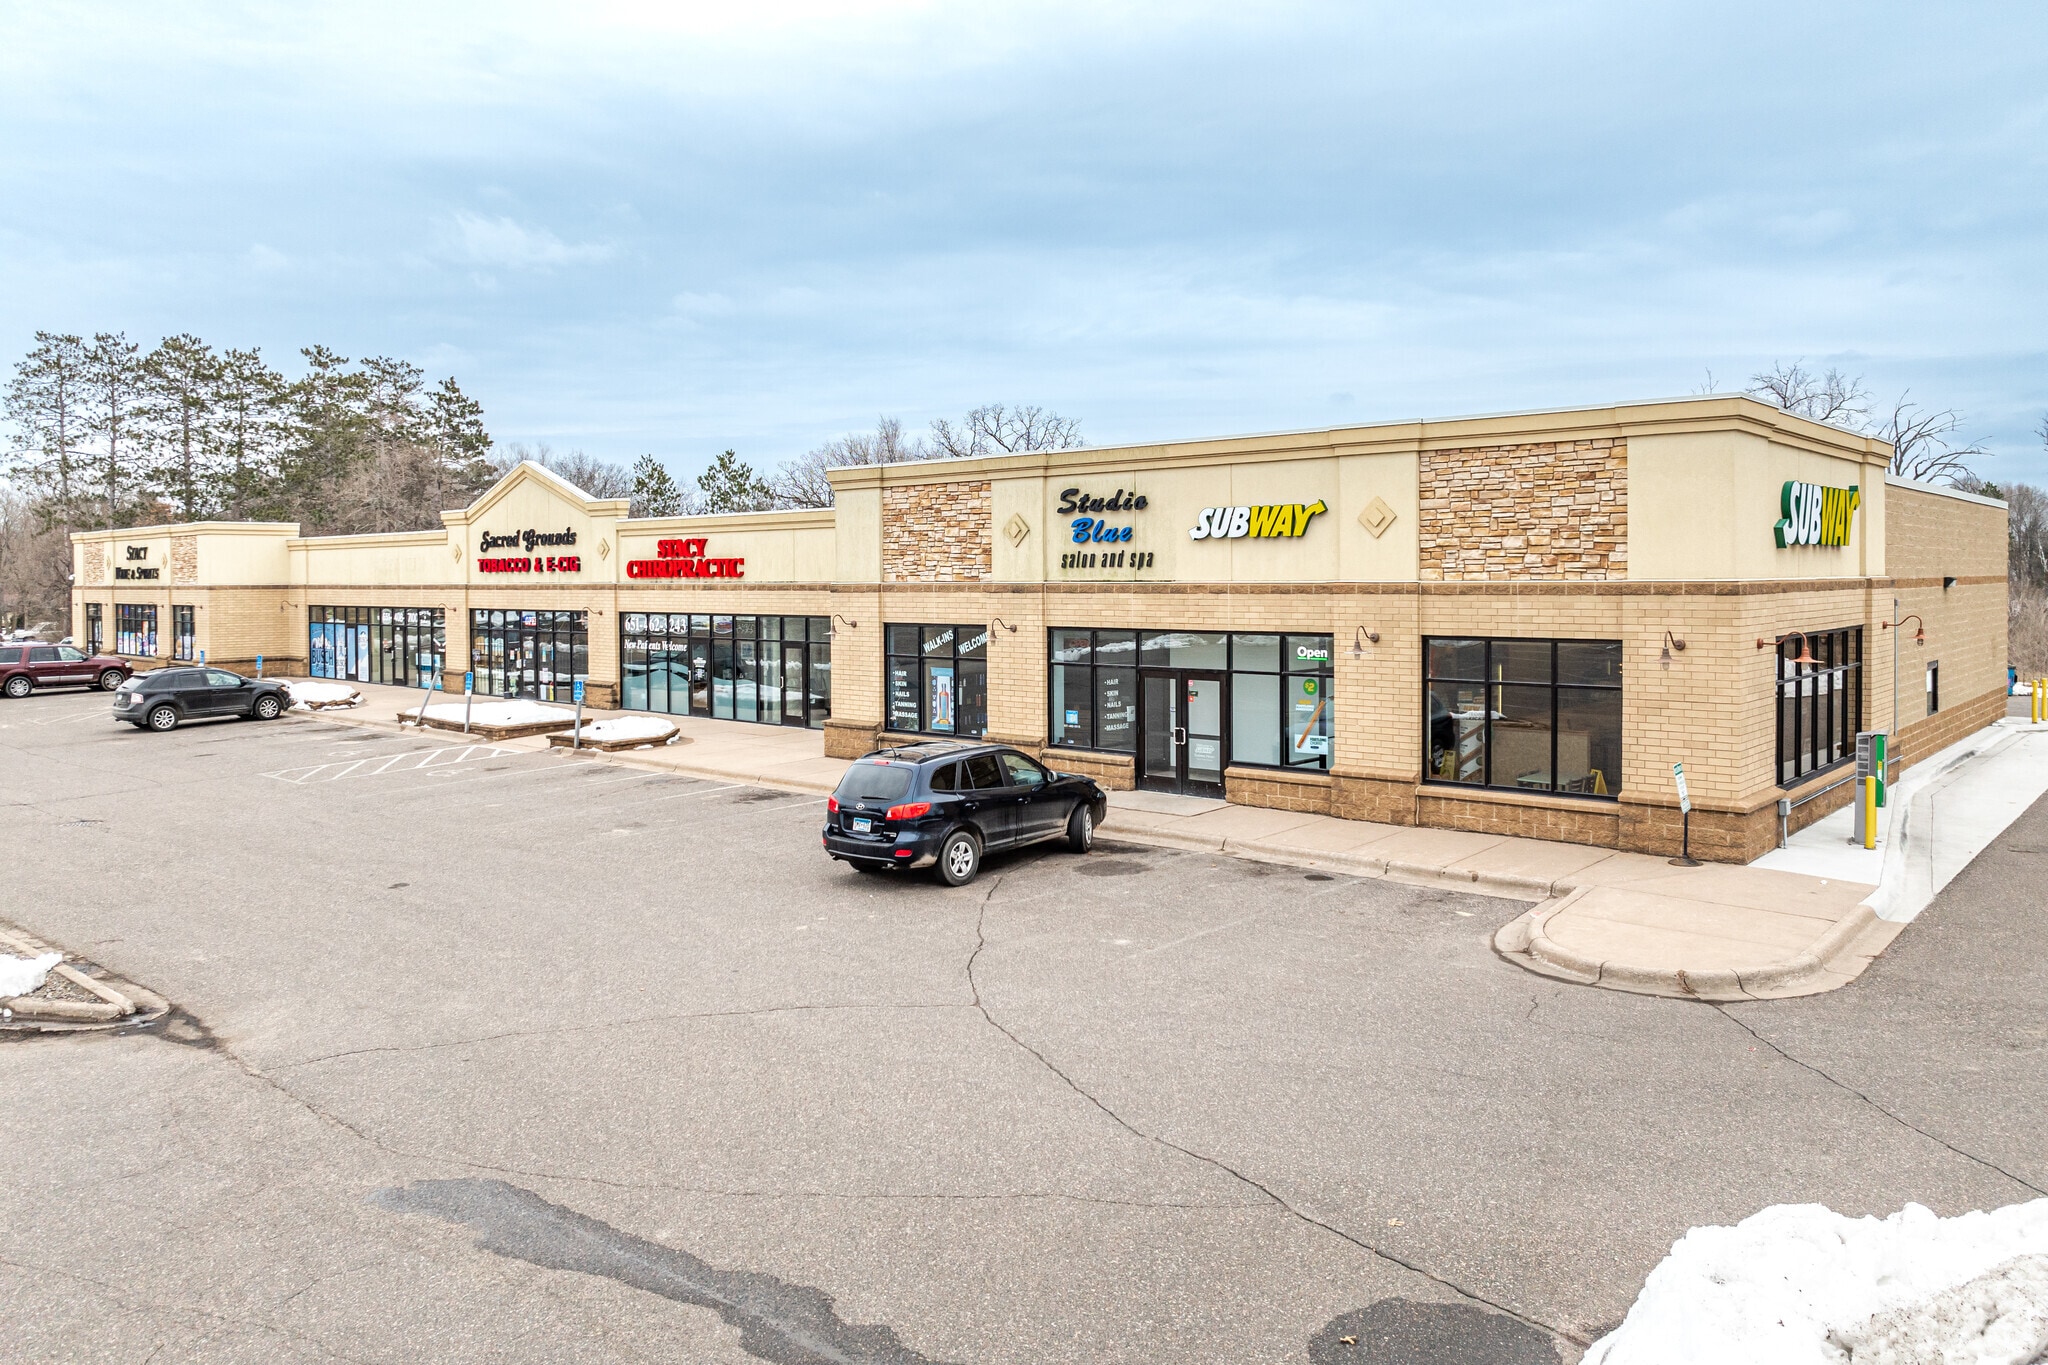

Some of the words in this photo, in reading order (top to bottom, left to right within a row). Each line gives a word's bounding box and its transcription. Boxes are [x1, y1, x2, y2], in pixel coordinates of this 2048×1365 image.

[1057, 488, 1148, 513] Studio
[1188, 499, 1328, 540] SUBWAY
[1777, 480, 1861, 548] SUBWAY
[480, 529, 520, 552] Sacred
[522, 527, 577, 552] Grounds
[1071, 517, 1133, 543] Blue
[657, 538, 708, 558] STACY
[477, 557, 531, 573] TOBACCO
[534, 557, 543, 573] &
[546, 556, 581, 572] E-CIG
[626, 558, 745, 578] CHIROPRACTIC
[1061, 551, 1096, 569] salon
[1101, 550, 1125, 568] and
[1129, 552, 1154, 571] spa
[923, 630, 954, 654] WALK-INS
[958, 631, 988, 655] WELCOM
[1297, 646, 1328, 660] Open
[1106, 678, 1119, 686] HAIR
[1305, 682, 1315, 692] $2
[894, 710, 918, 719] MASSAGE
[895, 701, 917, 709] TANNING
[1106, 722, 1130, 731] MASSAGE
